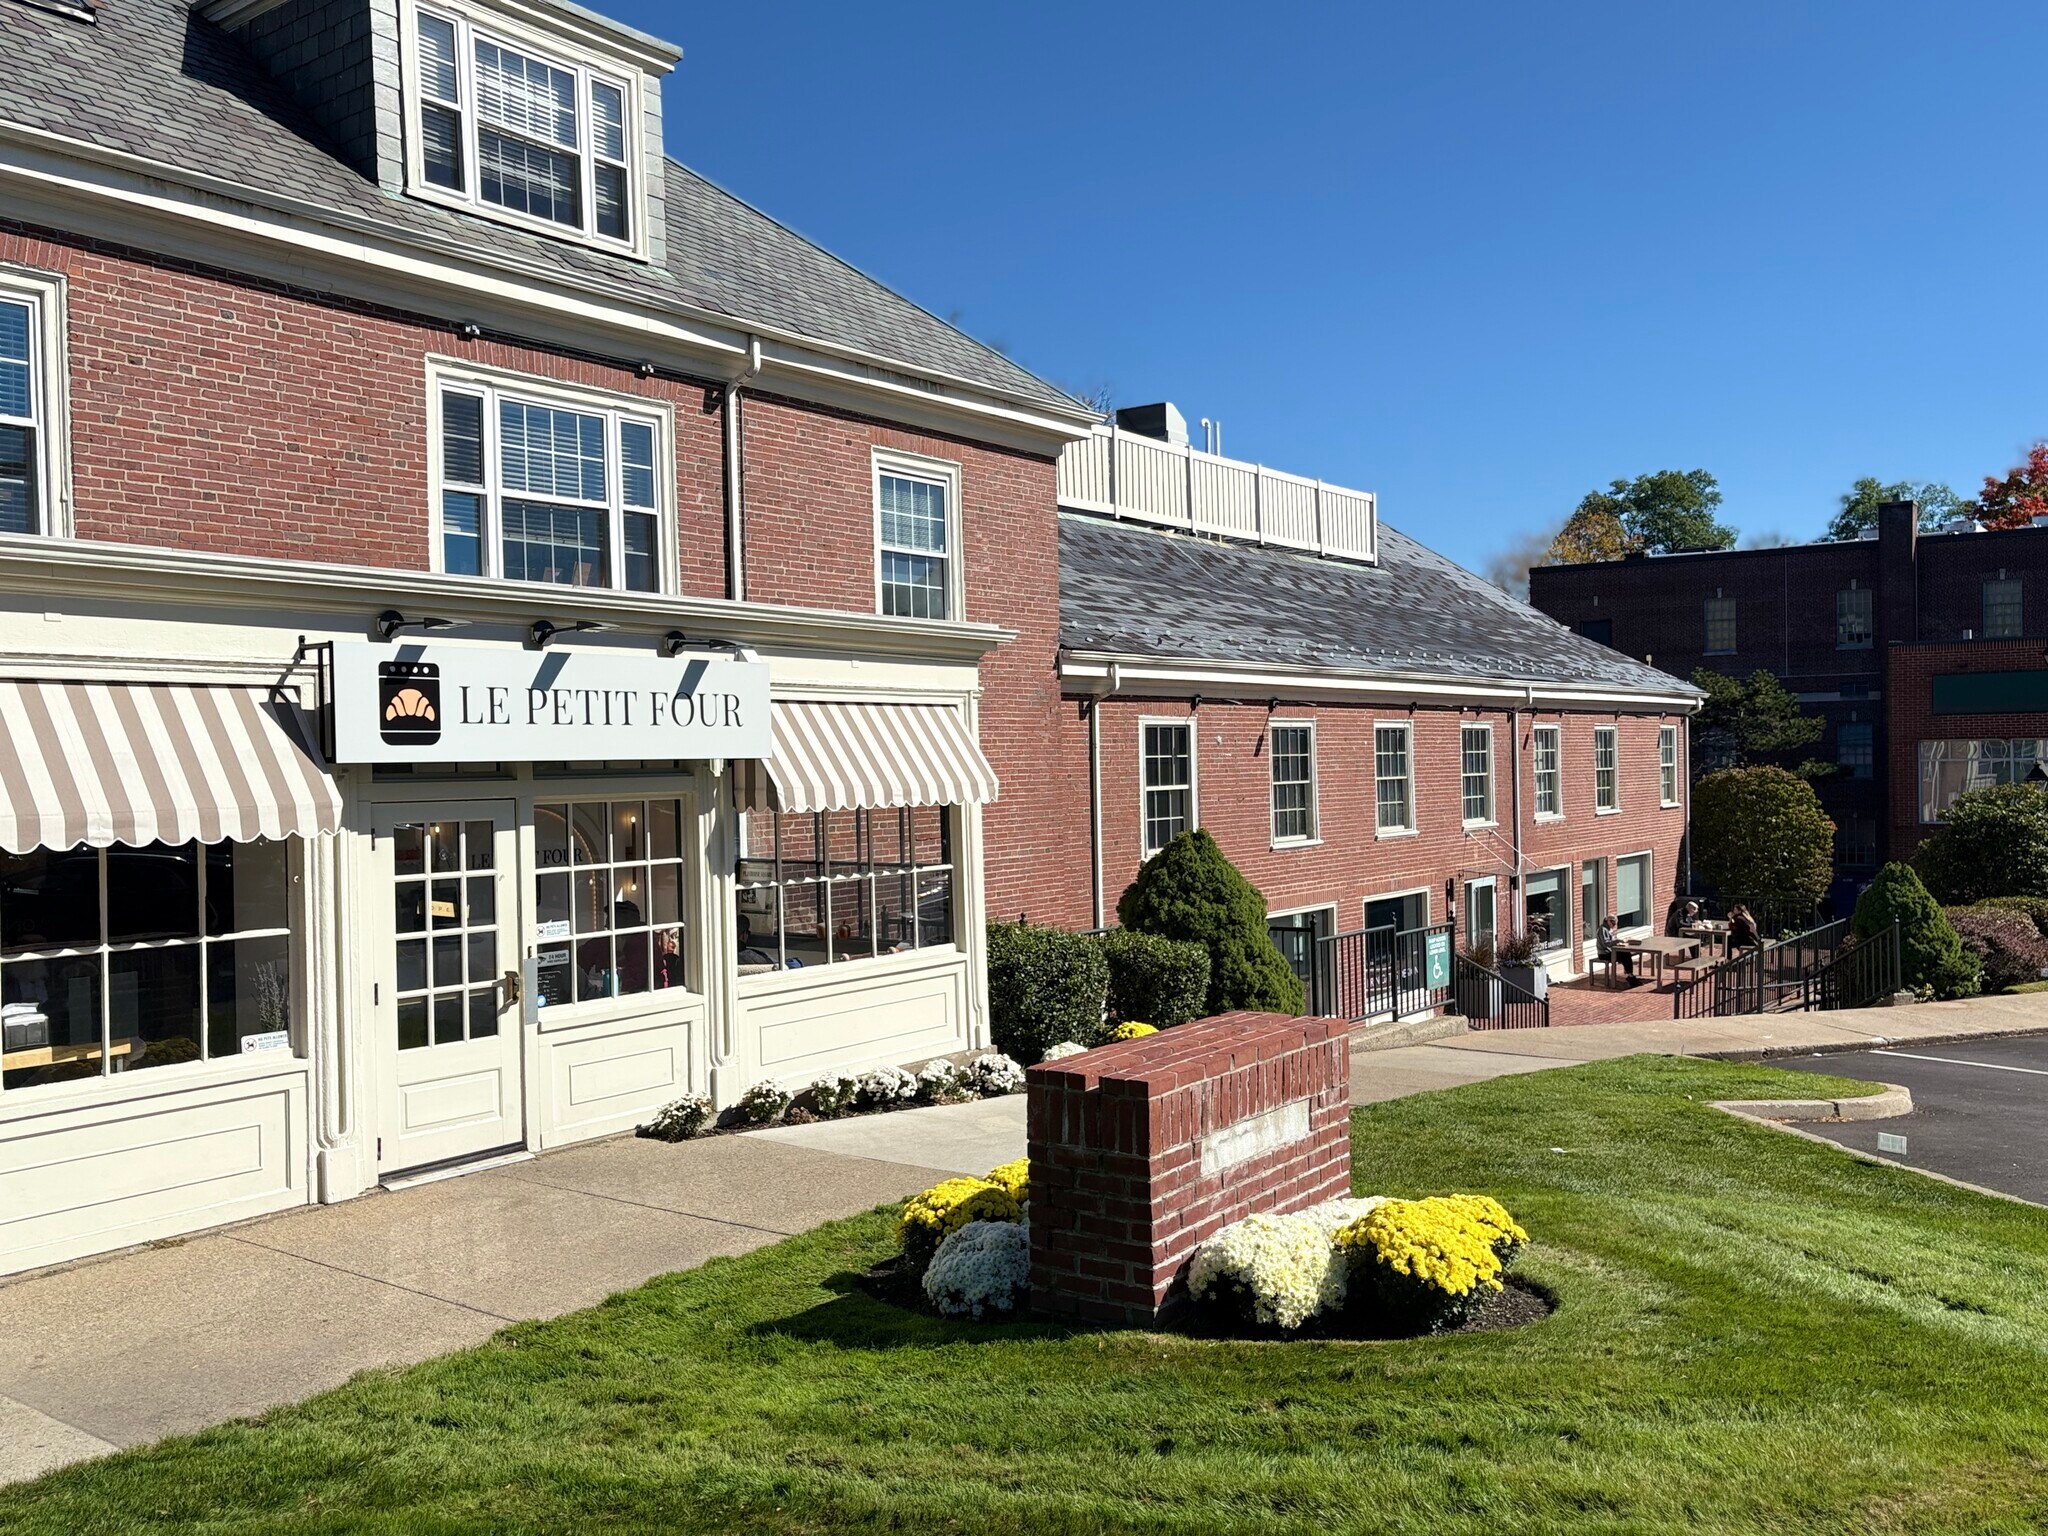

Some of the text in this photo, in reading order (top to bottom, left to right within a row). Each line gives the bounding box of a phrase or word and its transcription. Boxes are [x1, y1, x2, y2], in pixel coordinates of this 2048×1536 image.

[458, 685, 744, 728] LE PETIT FOUR
